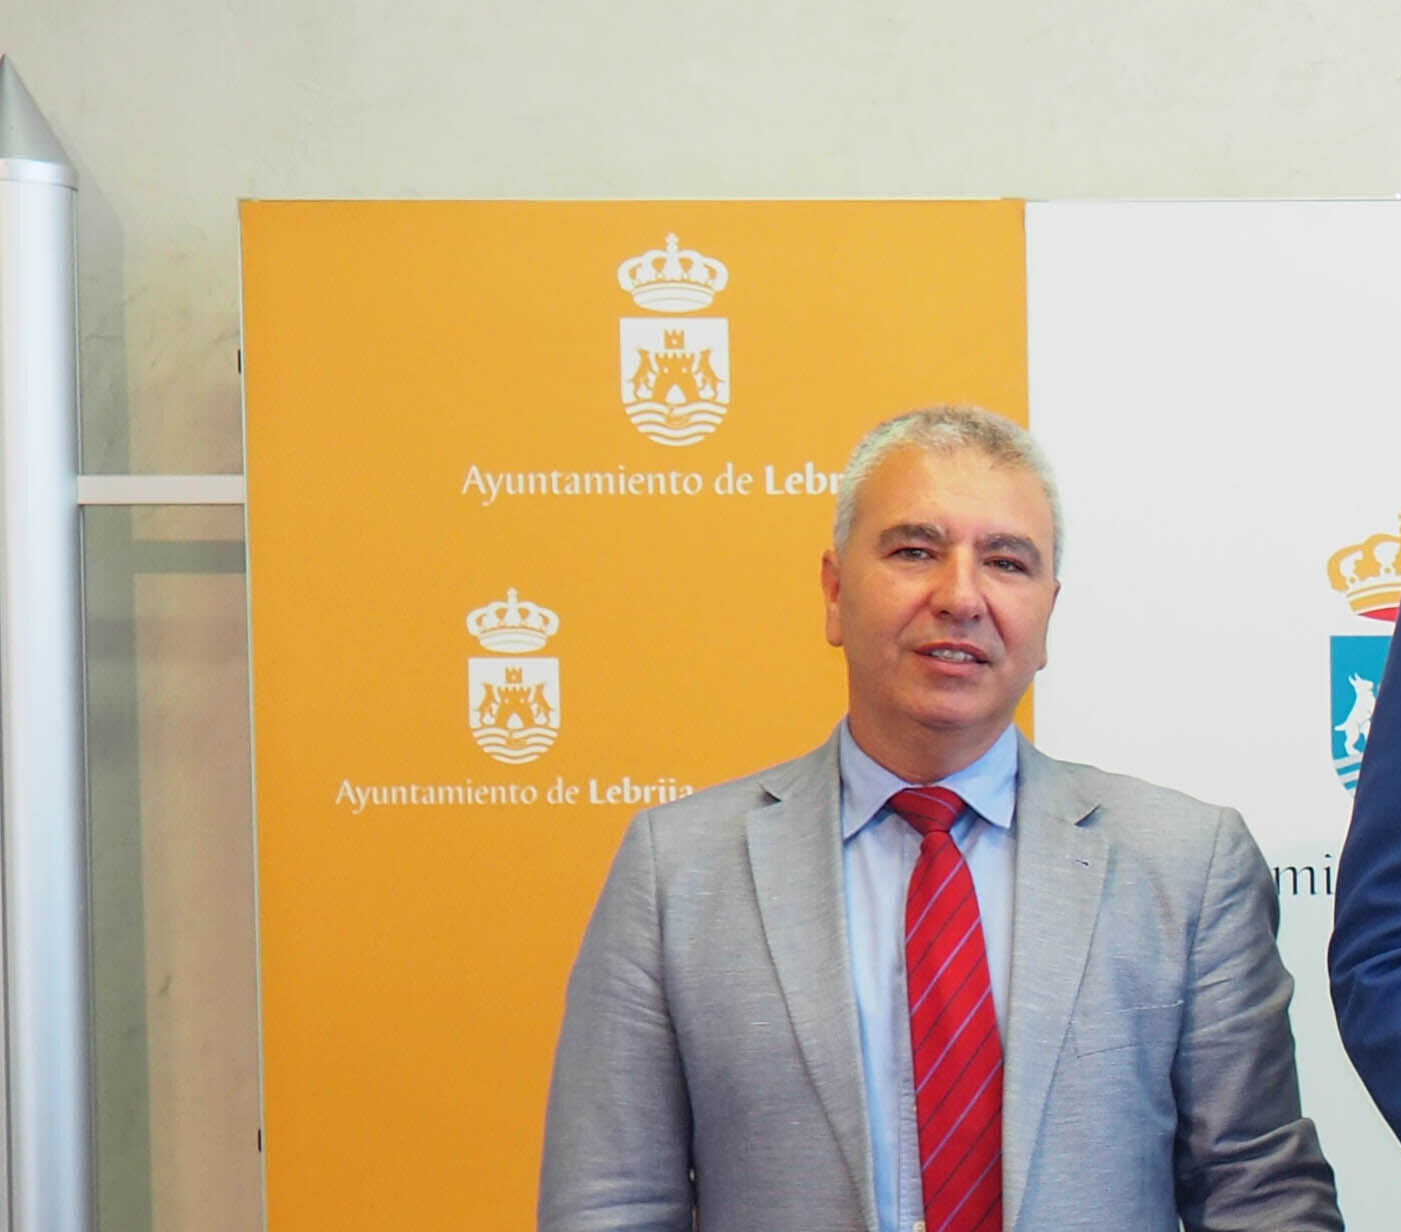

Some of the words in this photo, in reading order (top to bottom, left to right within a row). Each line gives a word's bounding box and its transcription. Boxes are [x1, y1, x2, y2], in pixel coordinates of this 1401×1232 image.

[461, 463, 703, 506] Ayuntamiento
[715, 463, 754, 496] de
[765, 461, 845, 496] Lebr
[335, 778, 538, 815] Ayuntamiento
[546, 776, 579, 805] de
